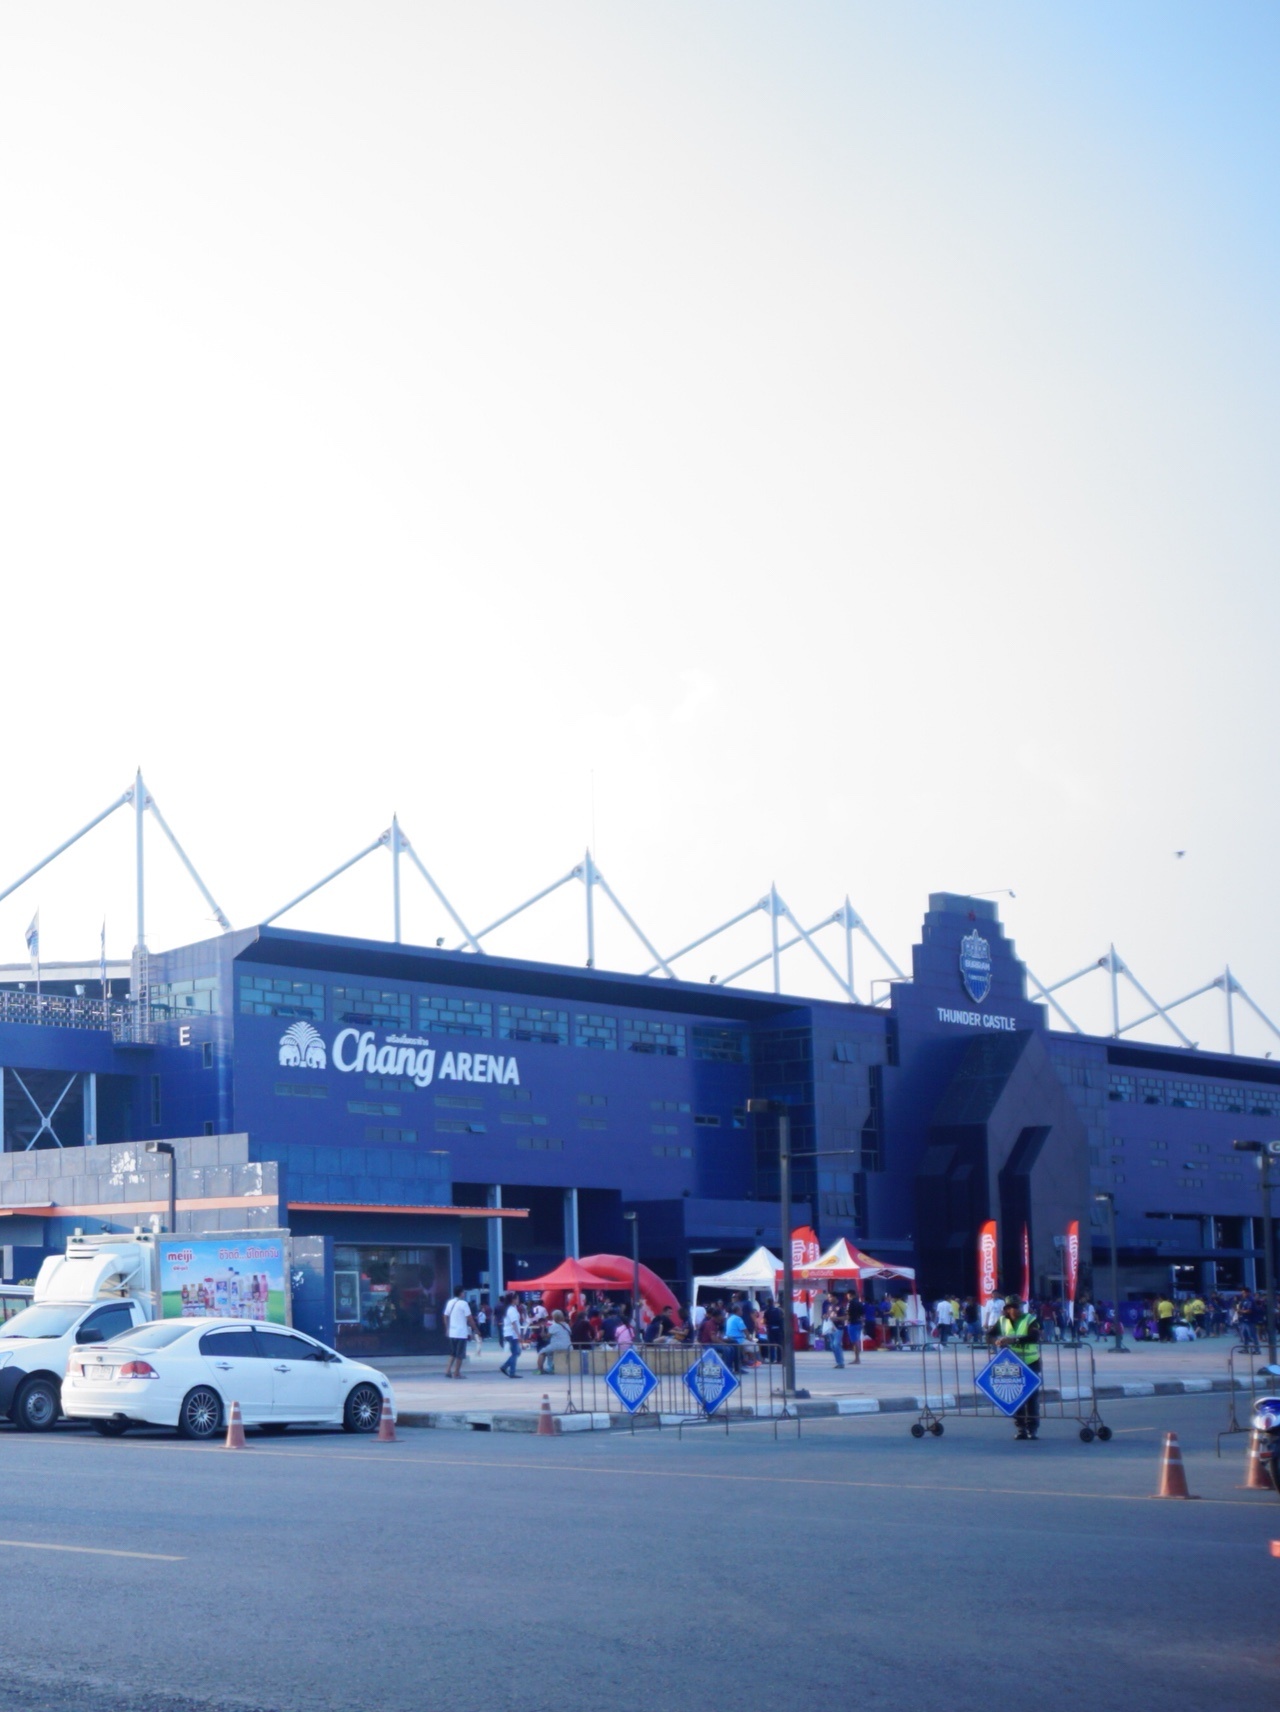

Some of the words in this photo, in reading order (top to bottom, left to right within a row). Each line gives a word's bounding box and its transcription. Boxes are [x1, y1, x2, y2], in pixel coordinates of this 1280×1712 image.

[937, 1007, 981, 1026] THUNDER
[982, 1014, 1016, 1031] CASTLE
[179, 1026, 190, 1046] E
[332, 1028, 436, 1087] Chang
[439, 1051, 520, 1086] ARENA
[168, 1250, 193, 1263] meiji
